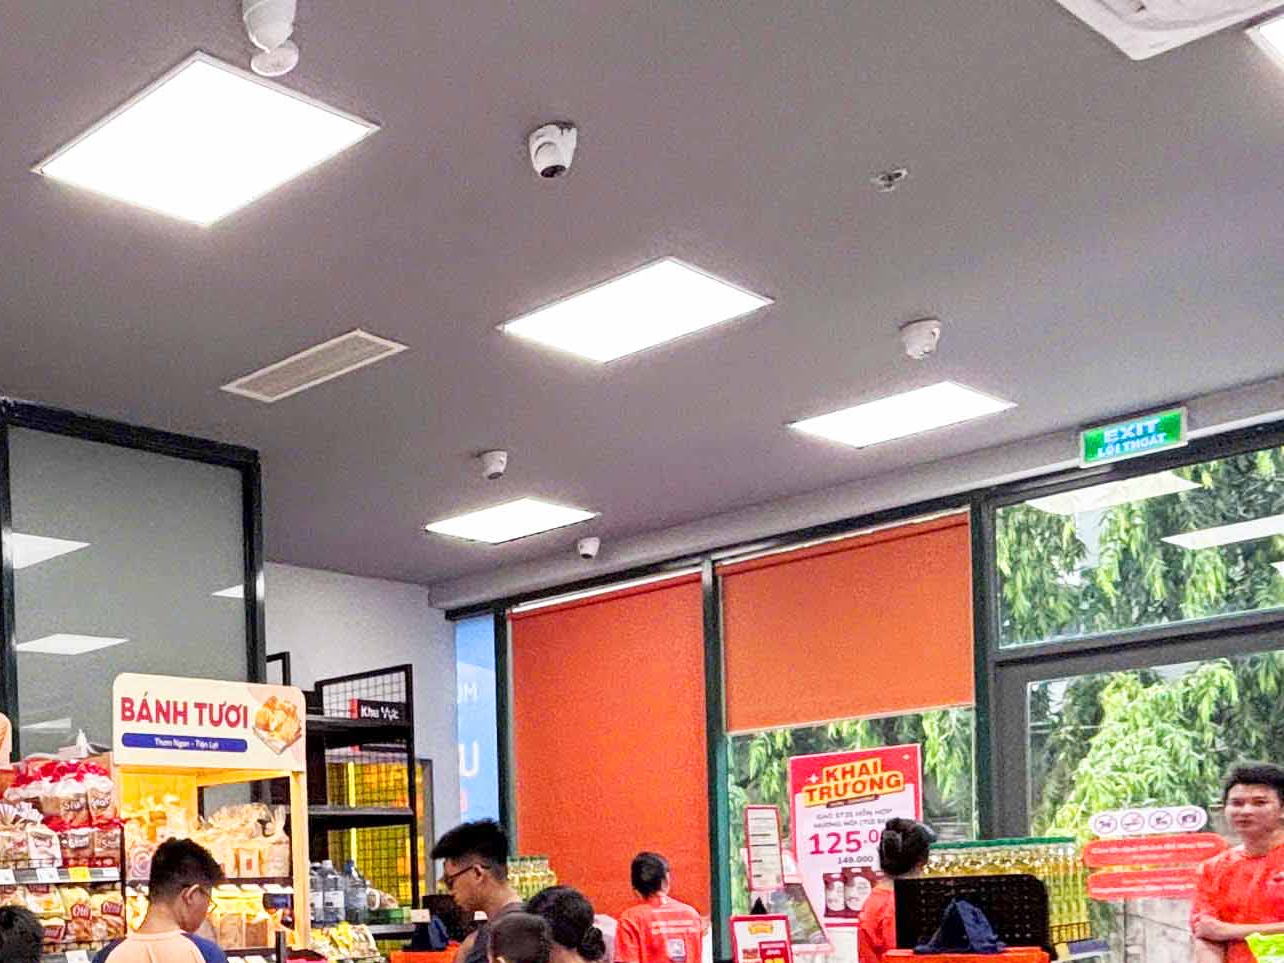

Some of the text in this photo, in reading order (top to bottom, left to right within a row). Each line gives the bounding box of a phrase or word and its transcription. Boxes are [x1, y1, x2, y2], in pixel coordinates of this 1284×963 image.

[1103, 418, 1161, 443] EXIT
[121, 692, 248, 728] BÁNH TƯƠI
[825, 762, 881, 783] KHAI
